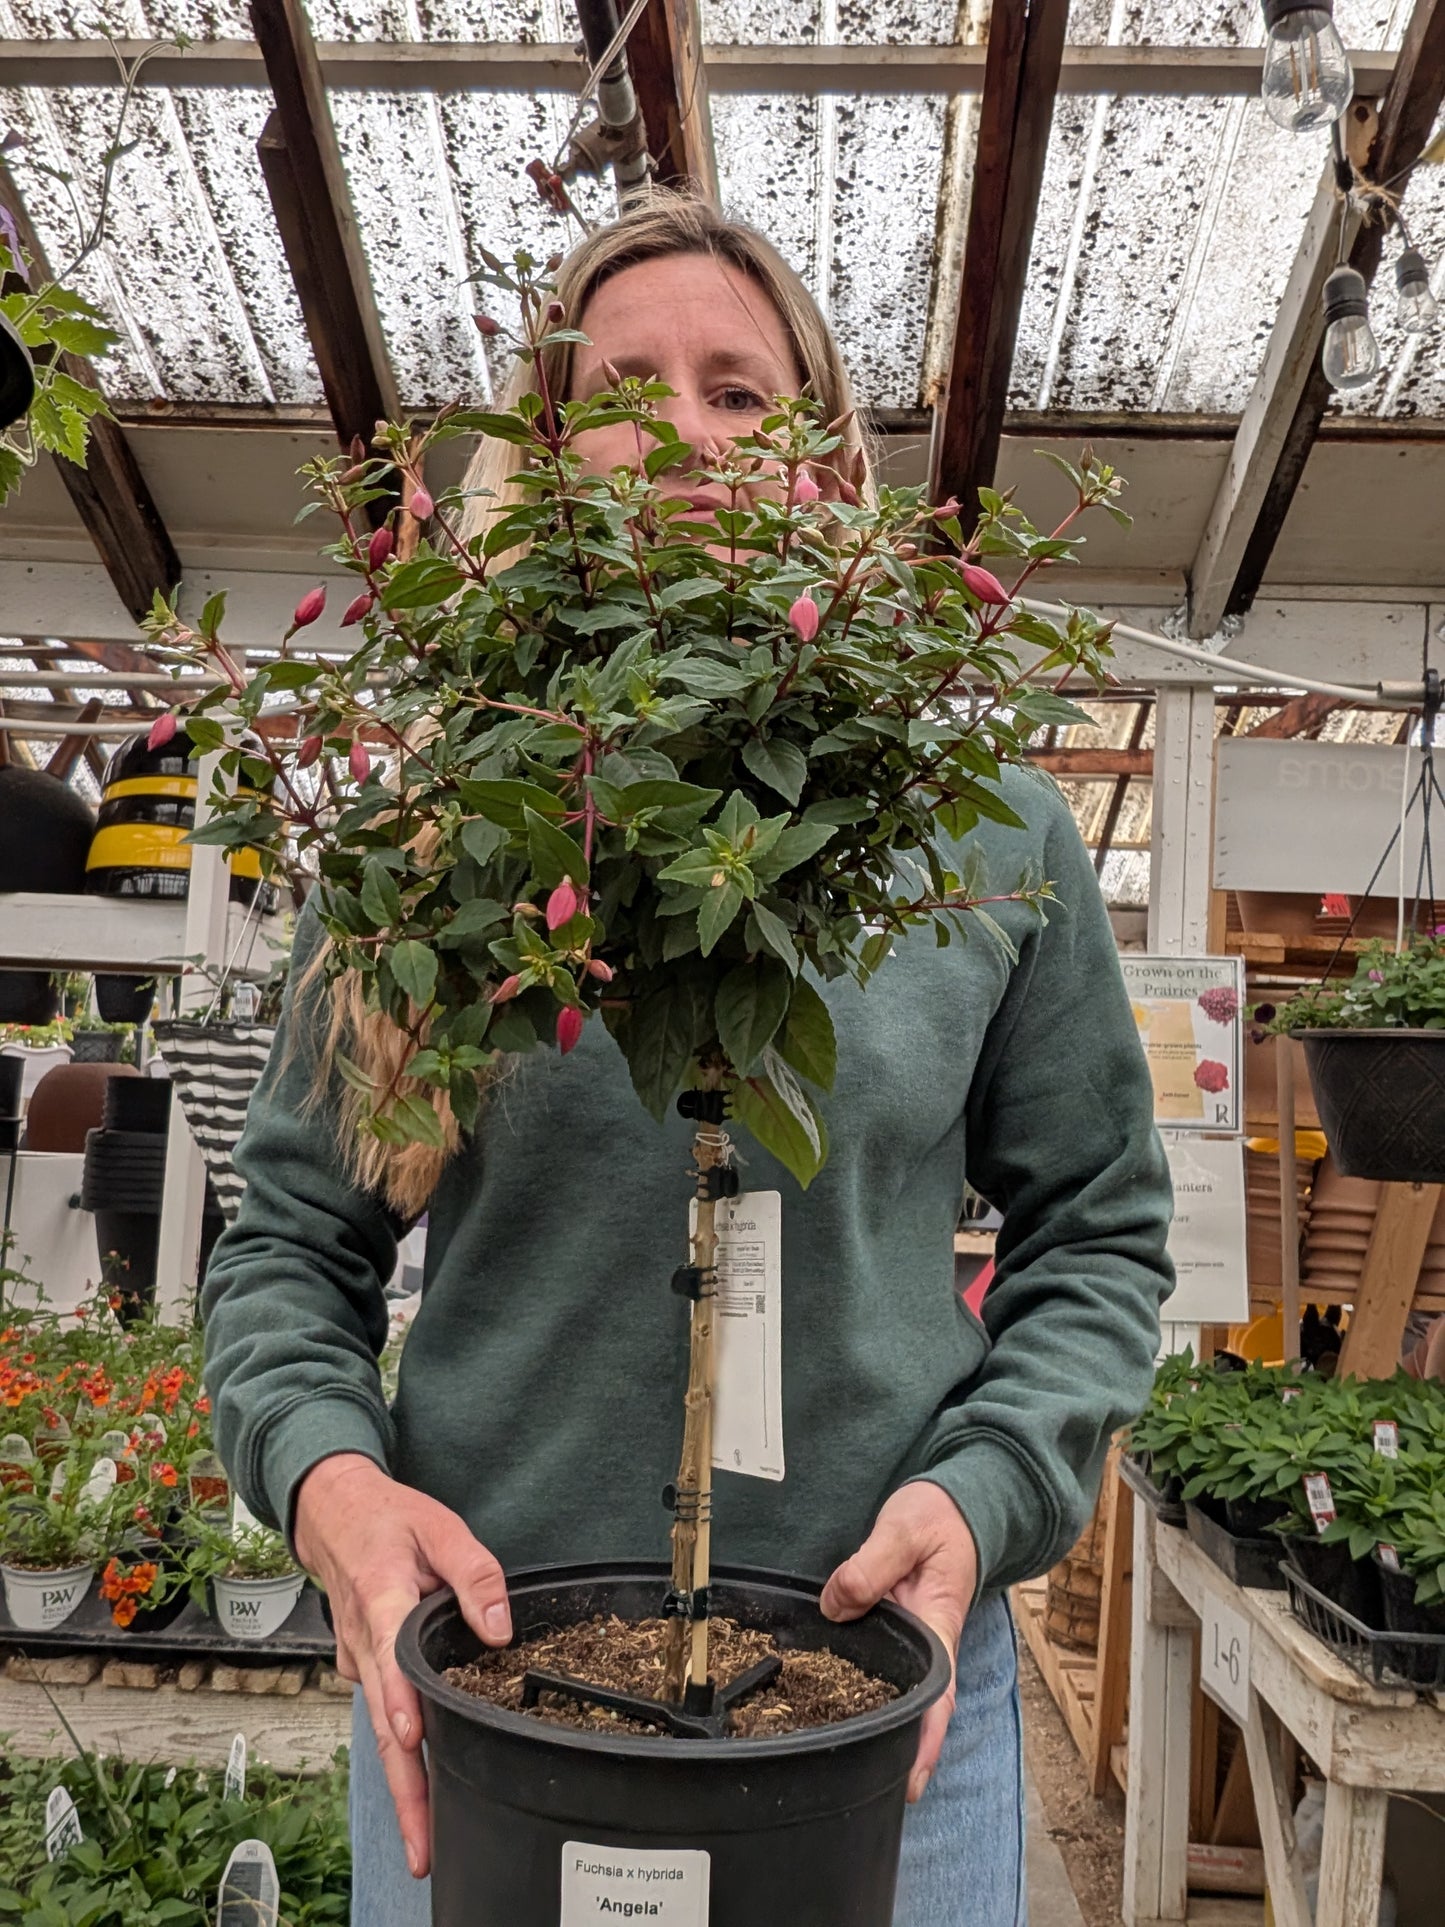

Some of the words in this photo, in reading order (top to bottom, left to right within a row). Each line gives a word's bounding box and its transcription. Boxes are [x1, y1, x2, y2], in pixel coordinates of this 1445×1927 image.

[1123, 965, 1172, 978] Grown
[1176, 967, 1195, 978] on
[1200, 966, 1222, 979] the
[1144, 983, 1198, 996] Prairies
[1174, 1183, 1213, 1193] anters
[1213, 1622, 1241, 1685] 1-6
[575, 1859, 623, 1878] Fuchsia
[626, 1868, 634, 1878] x
[637, 1867, 684, 1882] hybrida
[596, 1896, 663, 1917] 'Angela'
